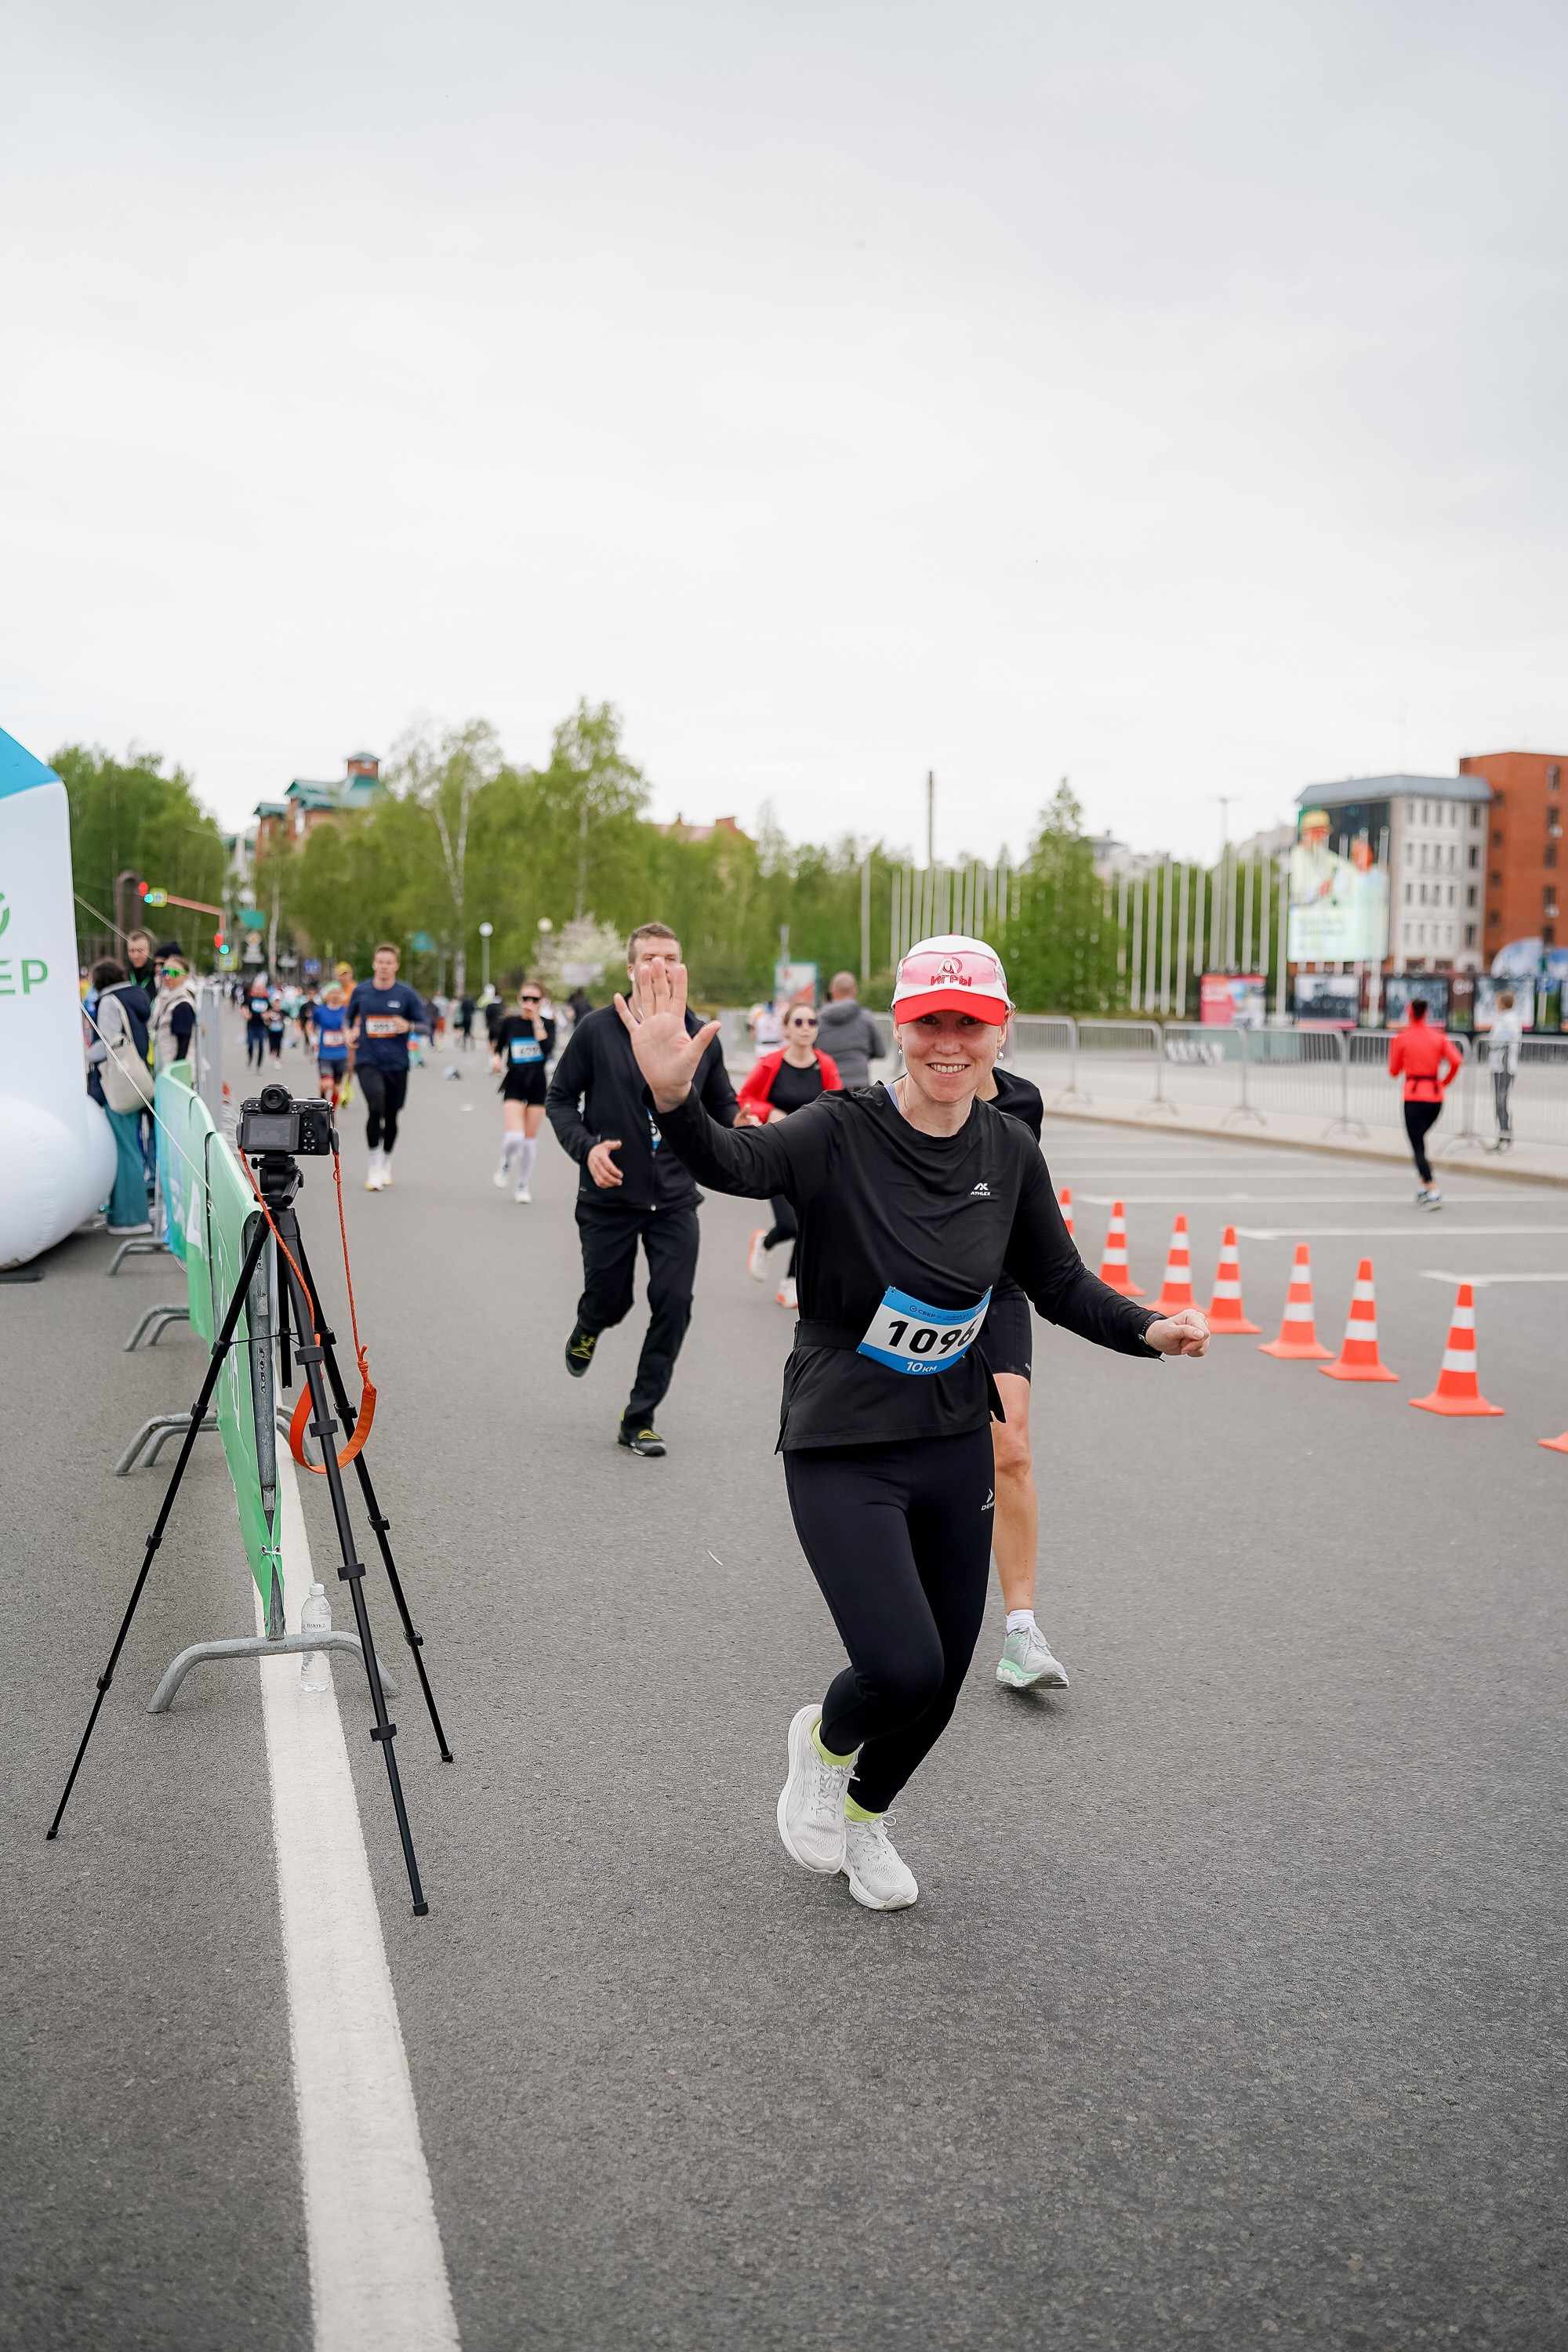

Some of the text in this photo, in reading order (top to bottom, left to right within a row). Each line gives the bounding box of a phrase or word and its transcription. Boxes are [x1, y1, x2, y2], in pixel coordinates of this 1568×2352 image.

[931, 975, 972, 987] ИГРЫ
[918, 1309, 936, 1318] СБЕР
[887, 1318, 979, 1355] 1096
